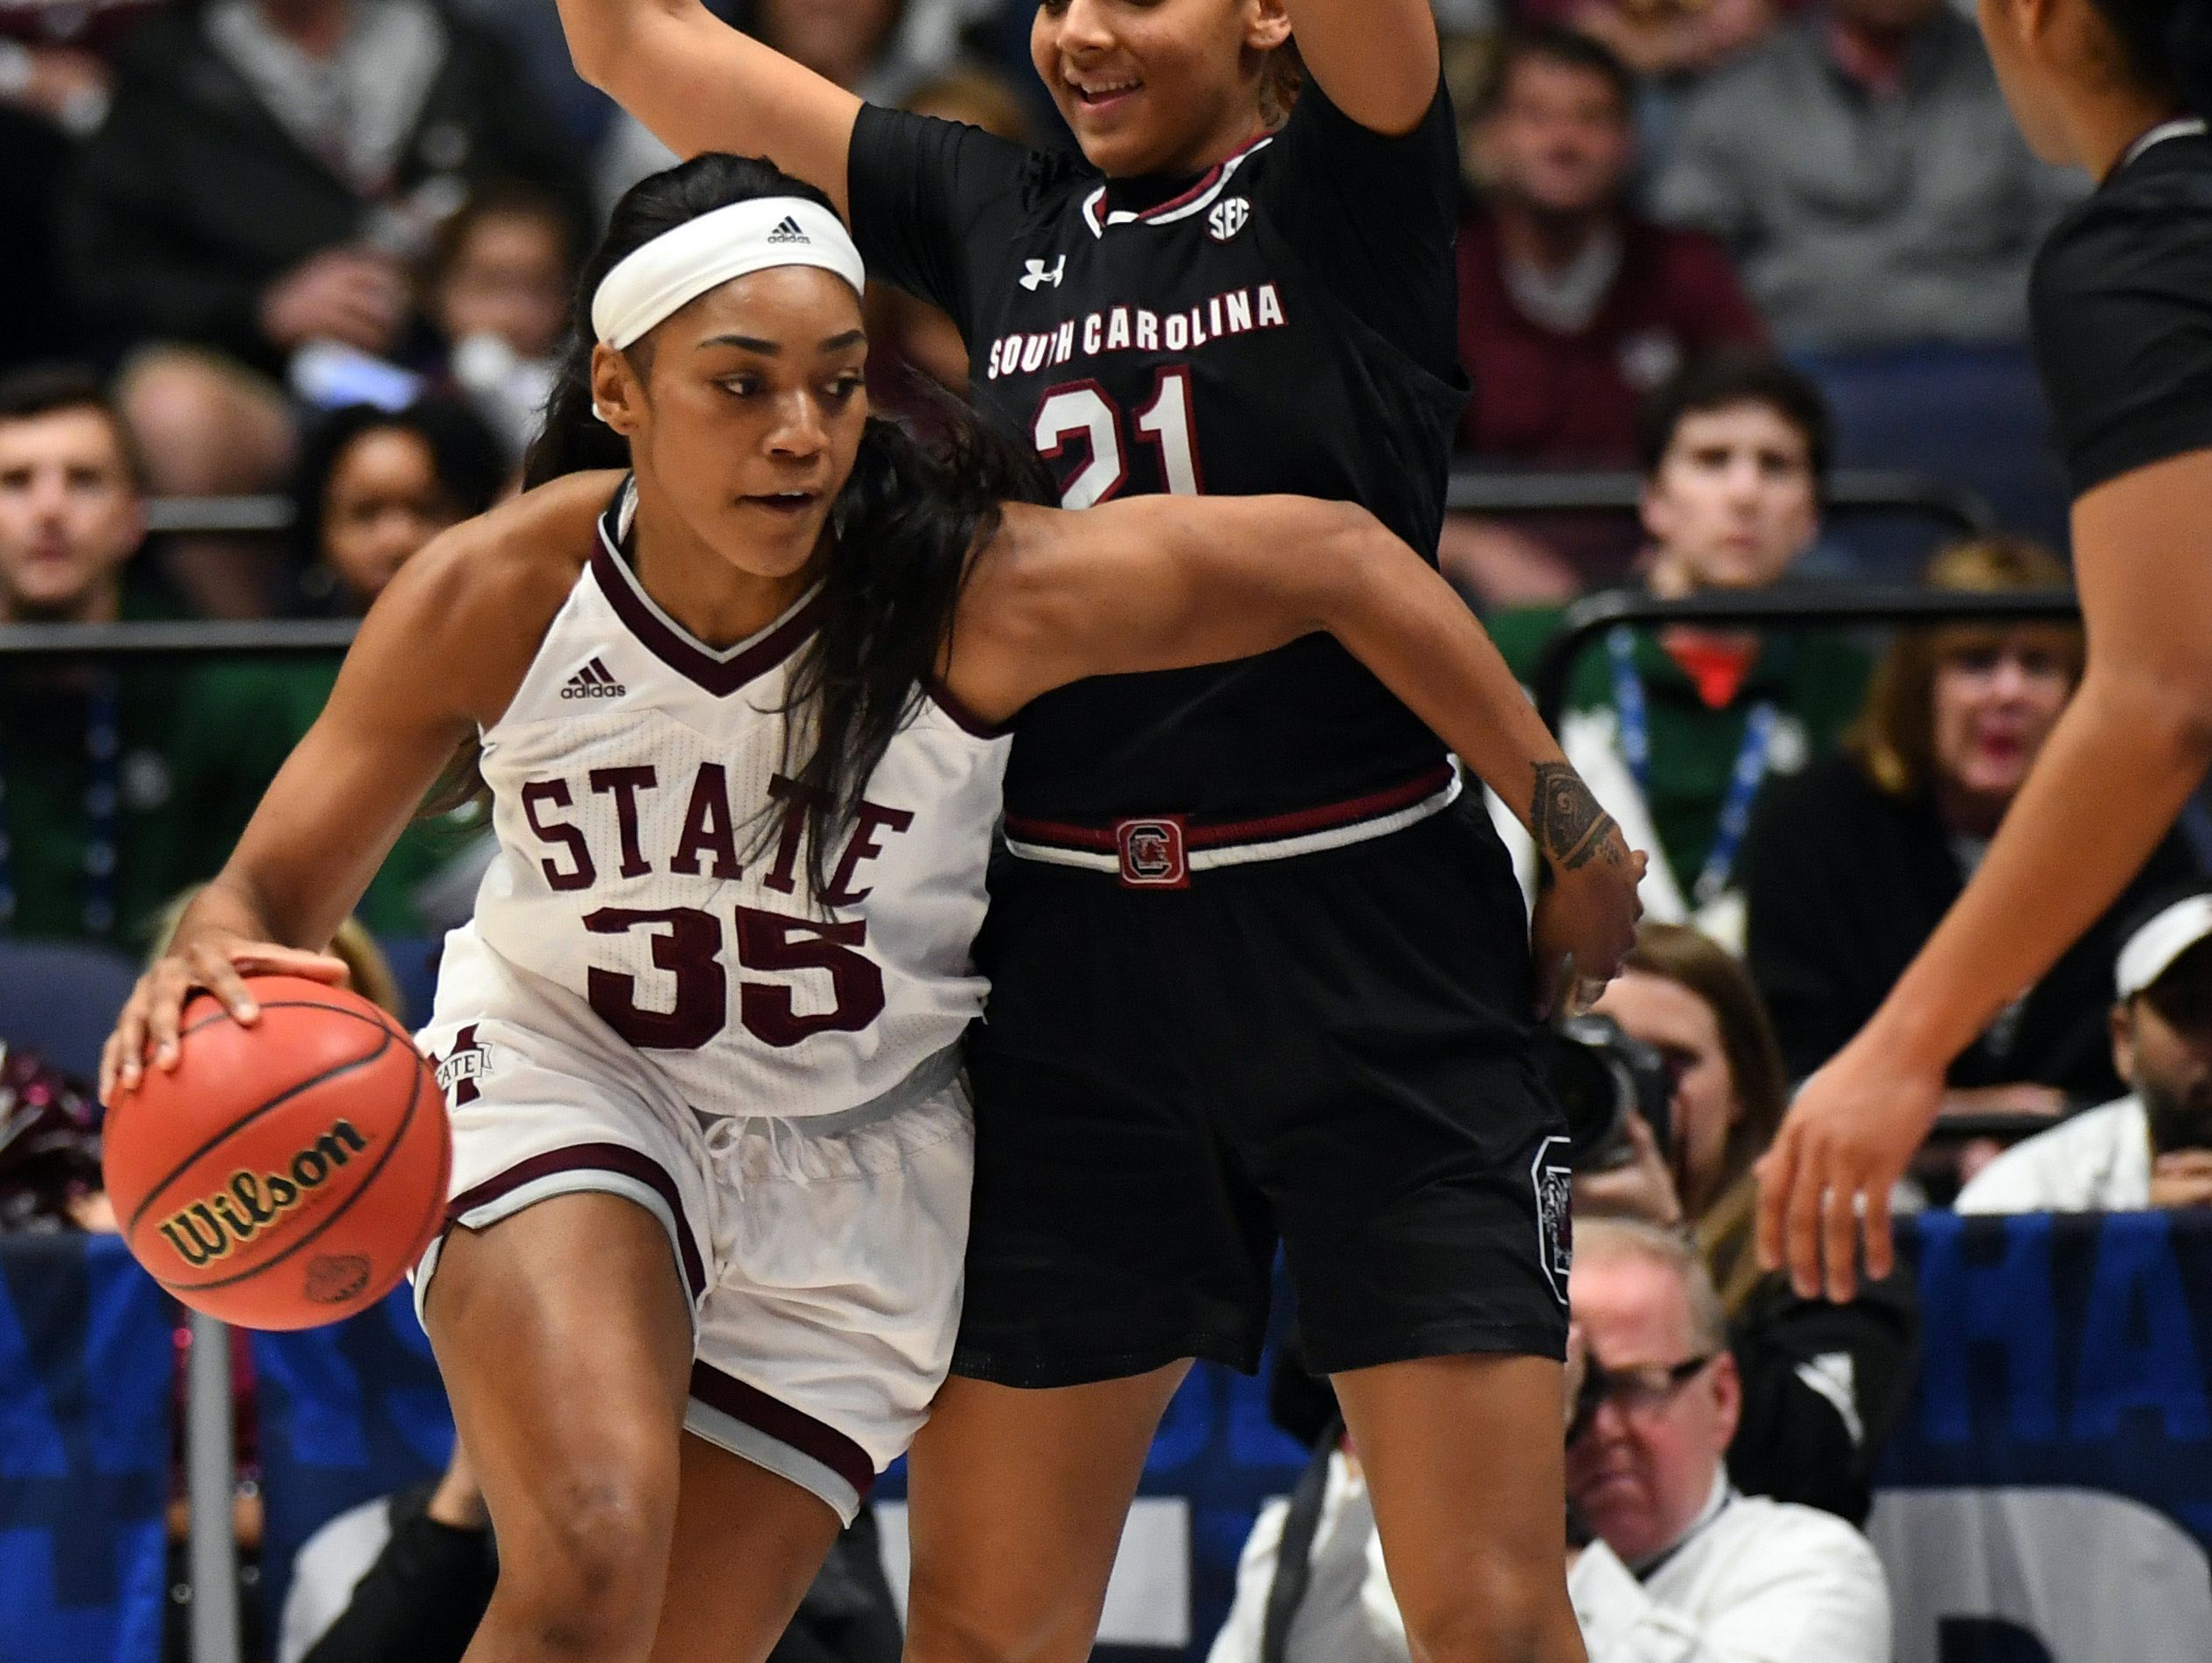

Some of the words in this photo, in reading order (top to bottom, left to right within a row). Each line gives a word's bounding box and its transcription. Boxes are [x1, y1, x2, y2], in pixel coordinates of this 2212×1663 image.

[767, 234, 811, 244] adidas
[1208, 197, 1250, 241] SEC
[987, 320, 1075, 380] SOUTH
[1082, 283, 1285, 356] CAROLINA
[1030, 363, 1204, 509] 21
[560, 682, 626, 699] adidas
[522, 762, 915, 906] STATE
[582, 905, 886, 1049] 35
[157, 1118, 367, 1266] Wilson
